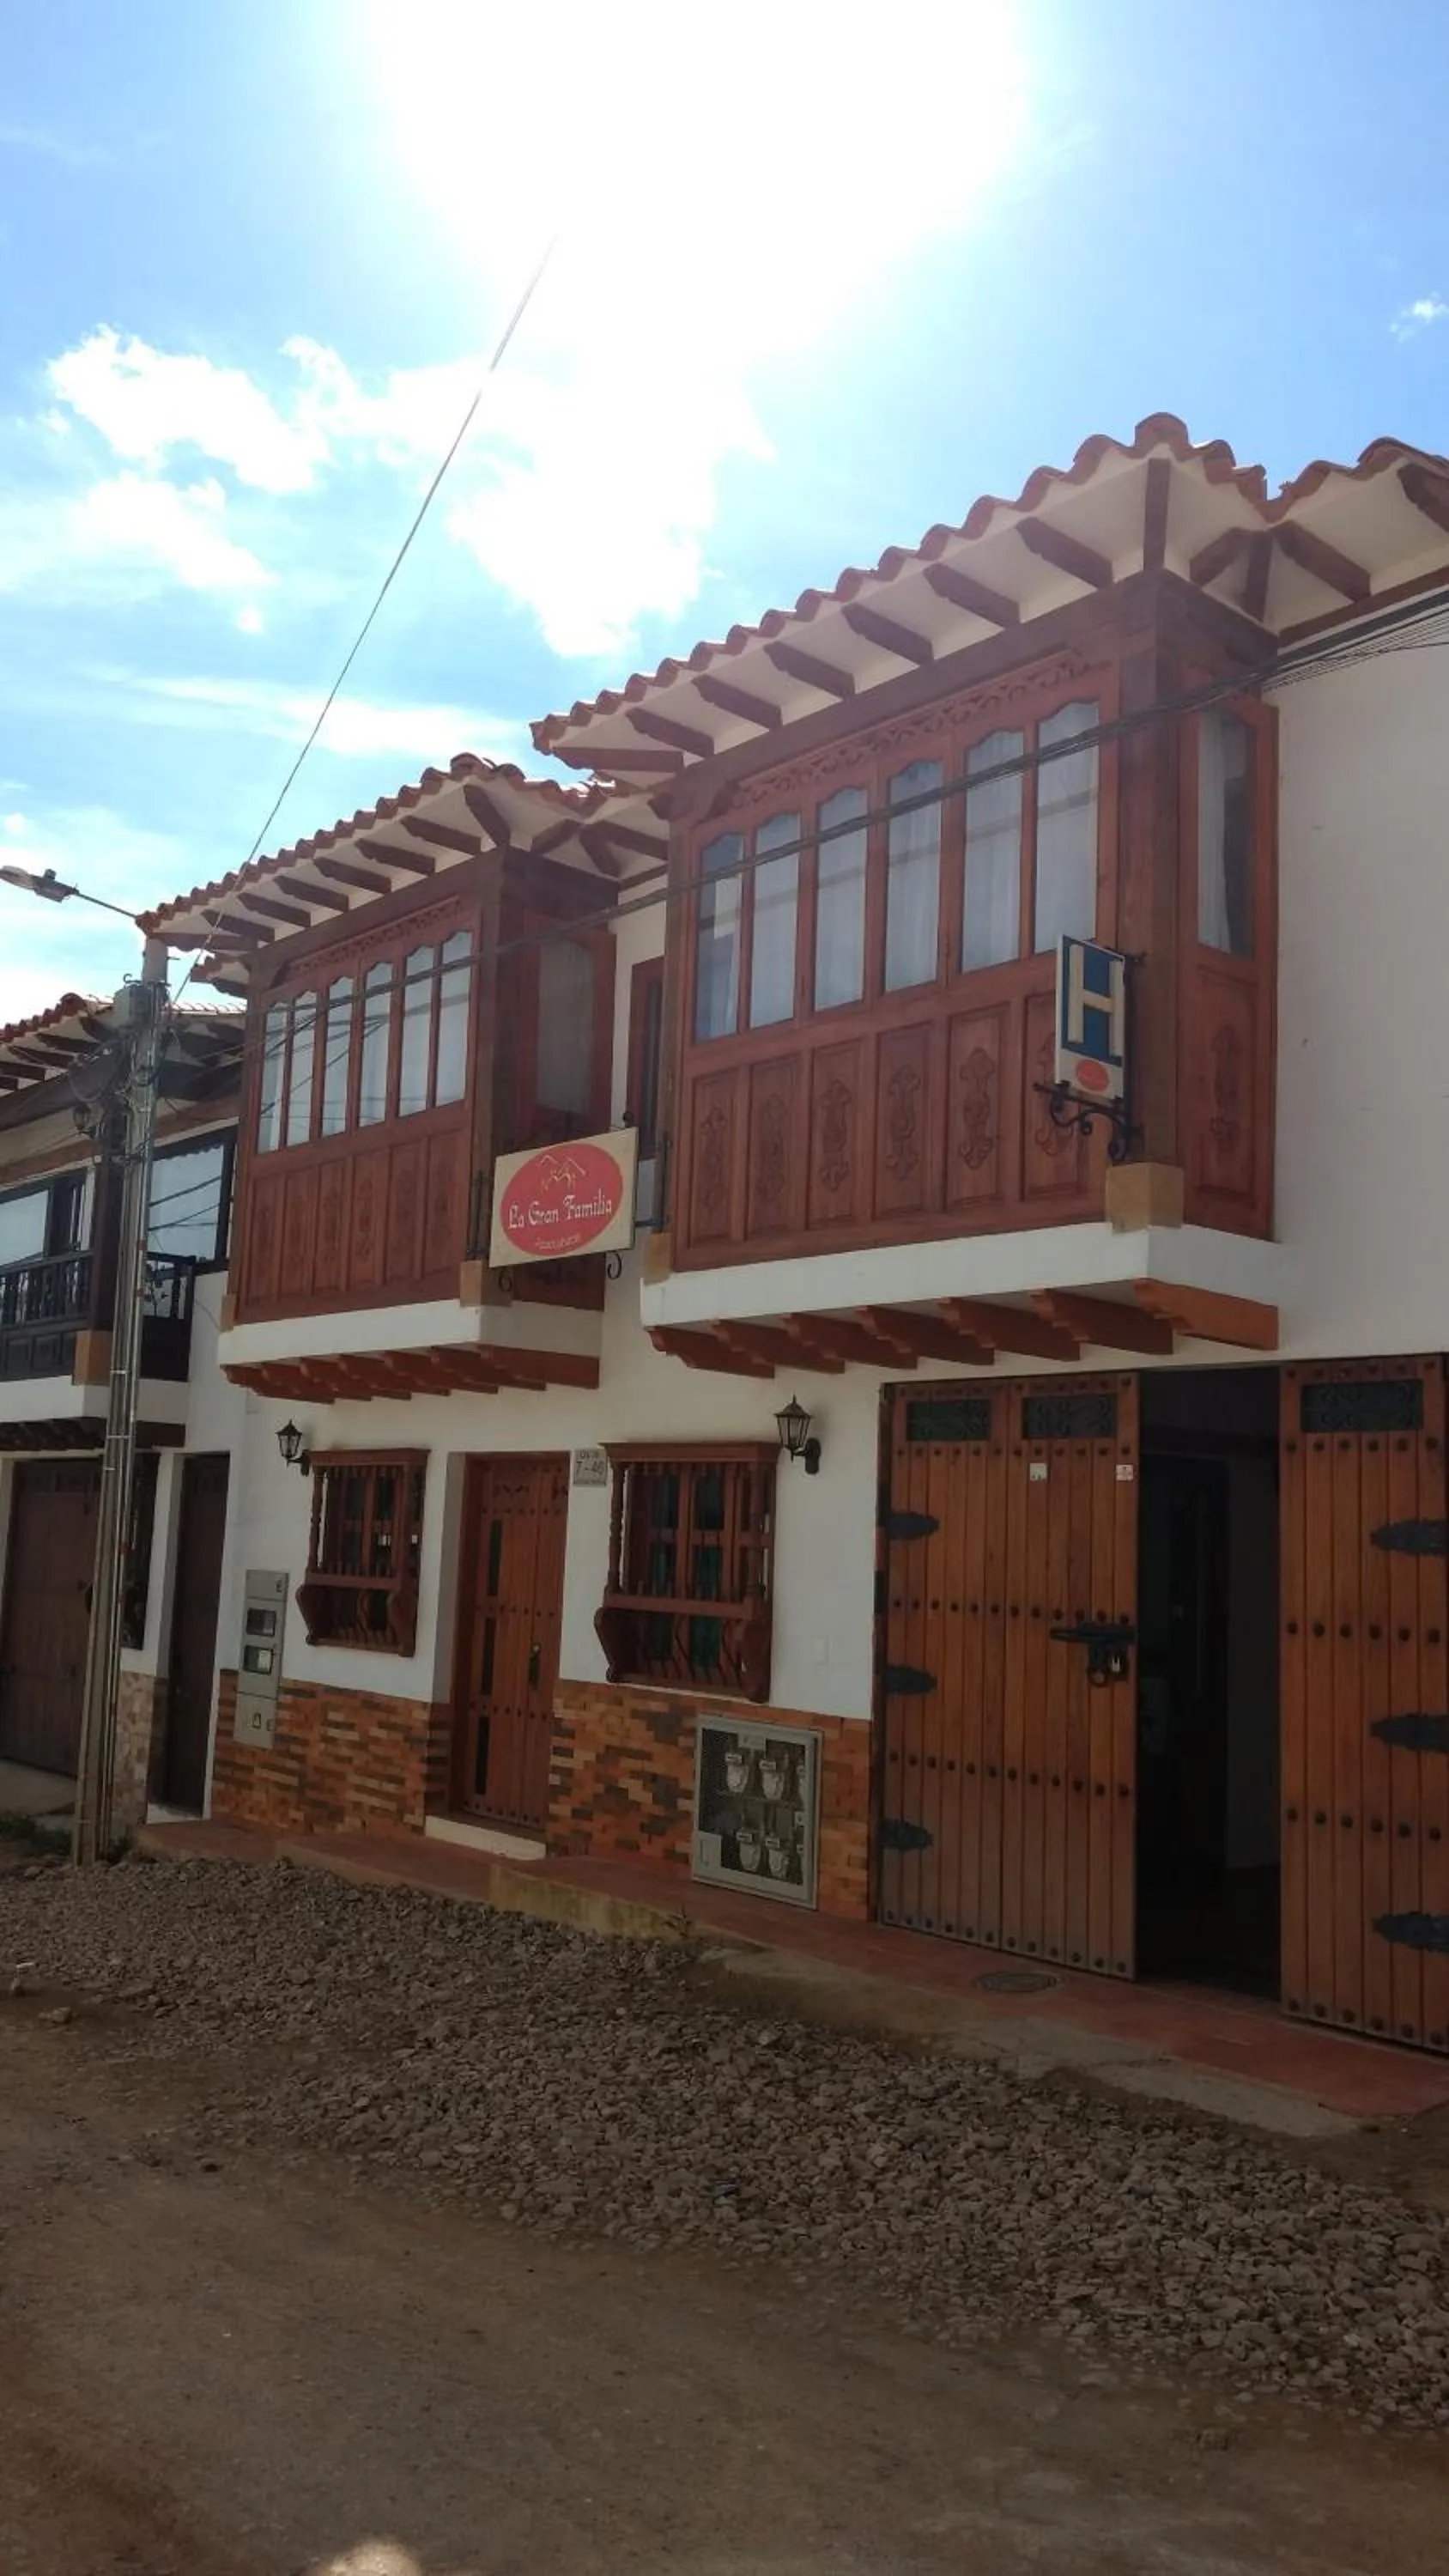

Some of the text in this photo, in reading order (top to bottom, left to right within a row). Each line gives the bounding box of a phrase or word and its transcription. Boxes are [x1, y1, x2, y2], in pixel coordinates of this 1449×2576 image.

[1067, 944, 1125, 1057] H
[508, 1188, 612, 1229] La Gran Familia
